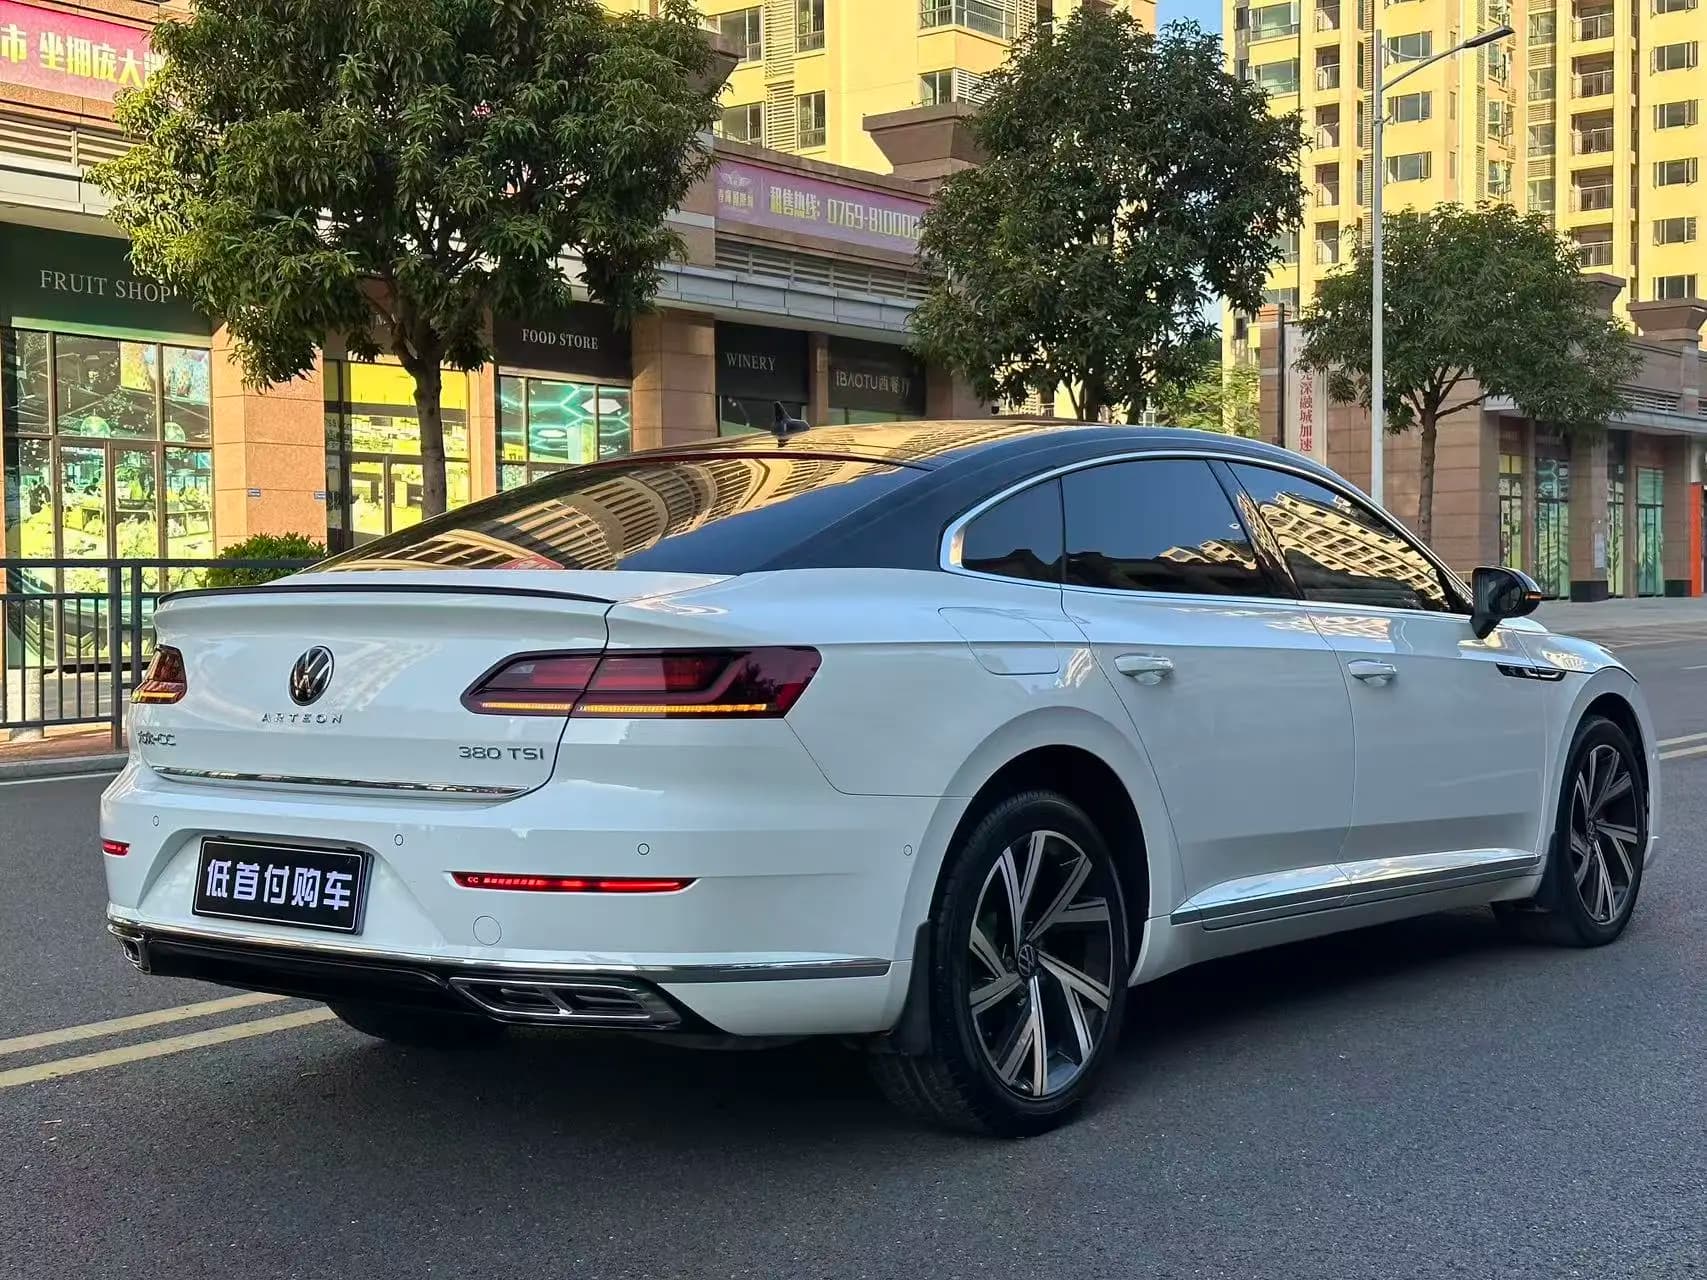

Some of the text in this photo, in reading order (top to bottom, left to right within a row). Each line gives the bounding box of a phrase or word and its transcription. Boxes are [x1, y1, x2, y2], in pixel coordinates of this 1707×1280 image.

[40, 270, 171, 303] FRUIT SHOP
[522, 328, 598, 349] FOOD STORE
[726, 352, 776, 371] WINERY
[261, 712, 343, 724] ARTEON
[459, 746, 544, 760] 380 TSI
[206, 858, 353, 911] 低首付购车
